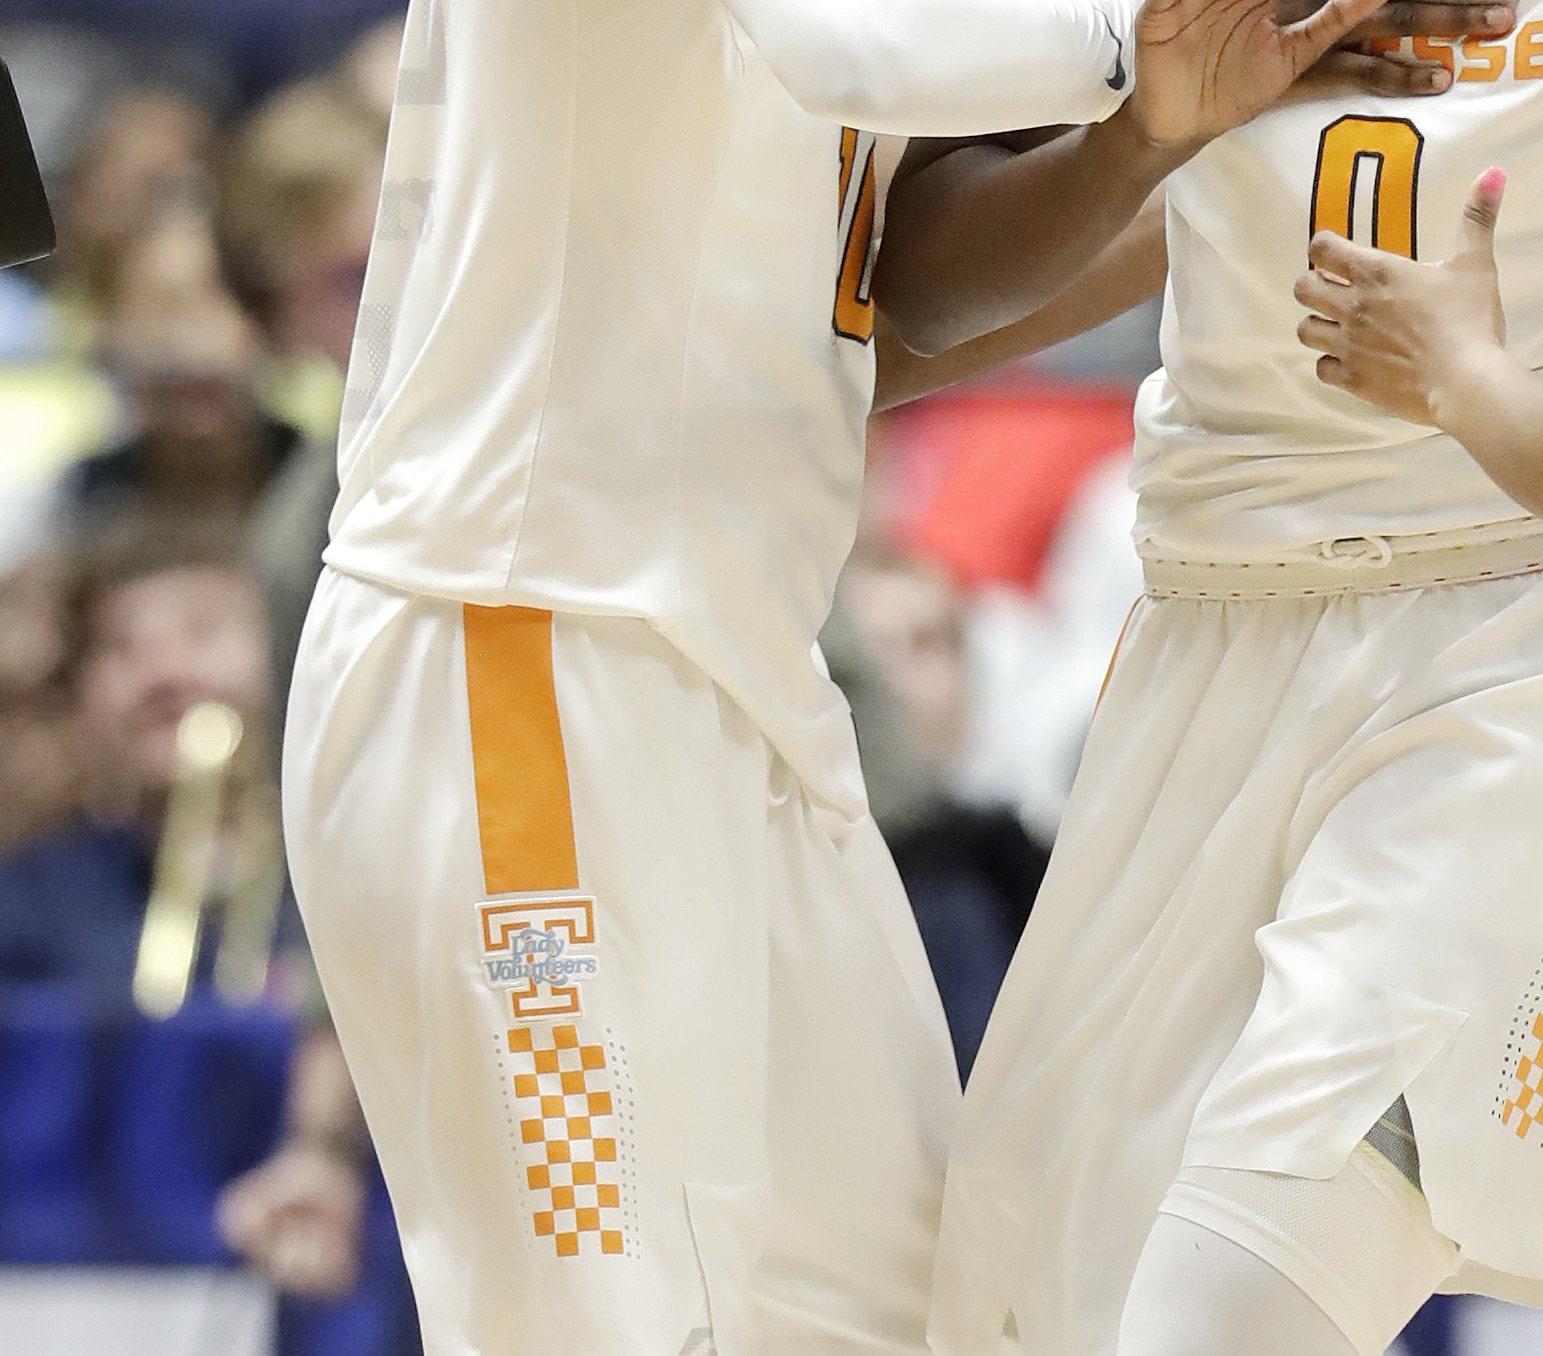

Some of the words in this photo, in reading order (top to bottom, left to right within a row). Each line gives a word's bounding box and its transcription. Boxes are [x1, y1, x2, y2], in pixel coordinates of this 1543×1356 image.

[1309, 113, 1425, 285] 0
[511, 928, 565, 963] Lady
[485, 958, 597, 986] Volunteers
